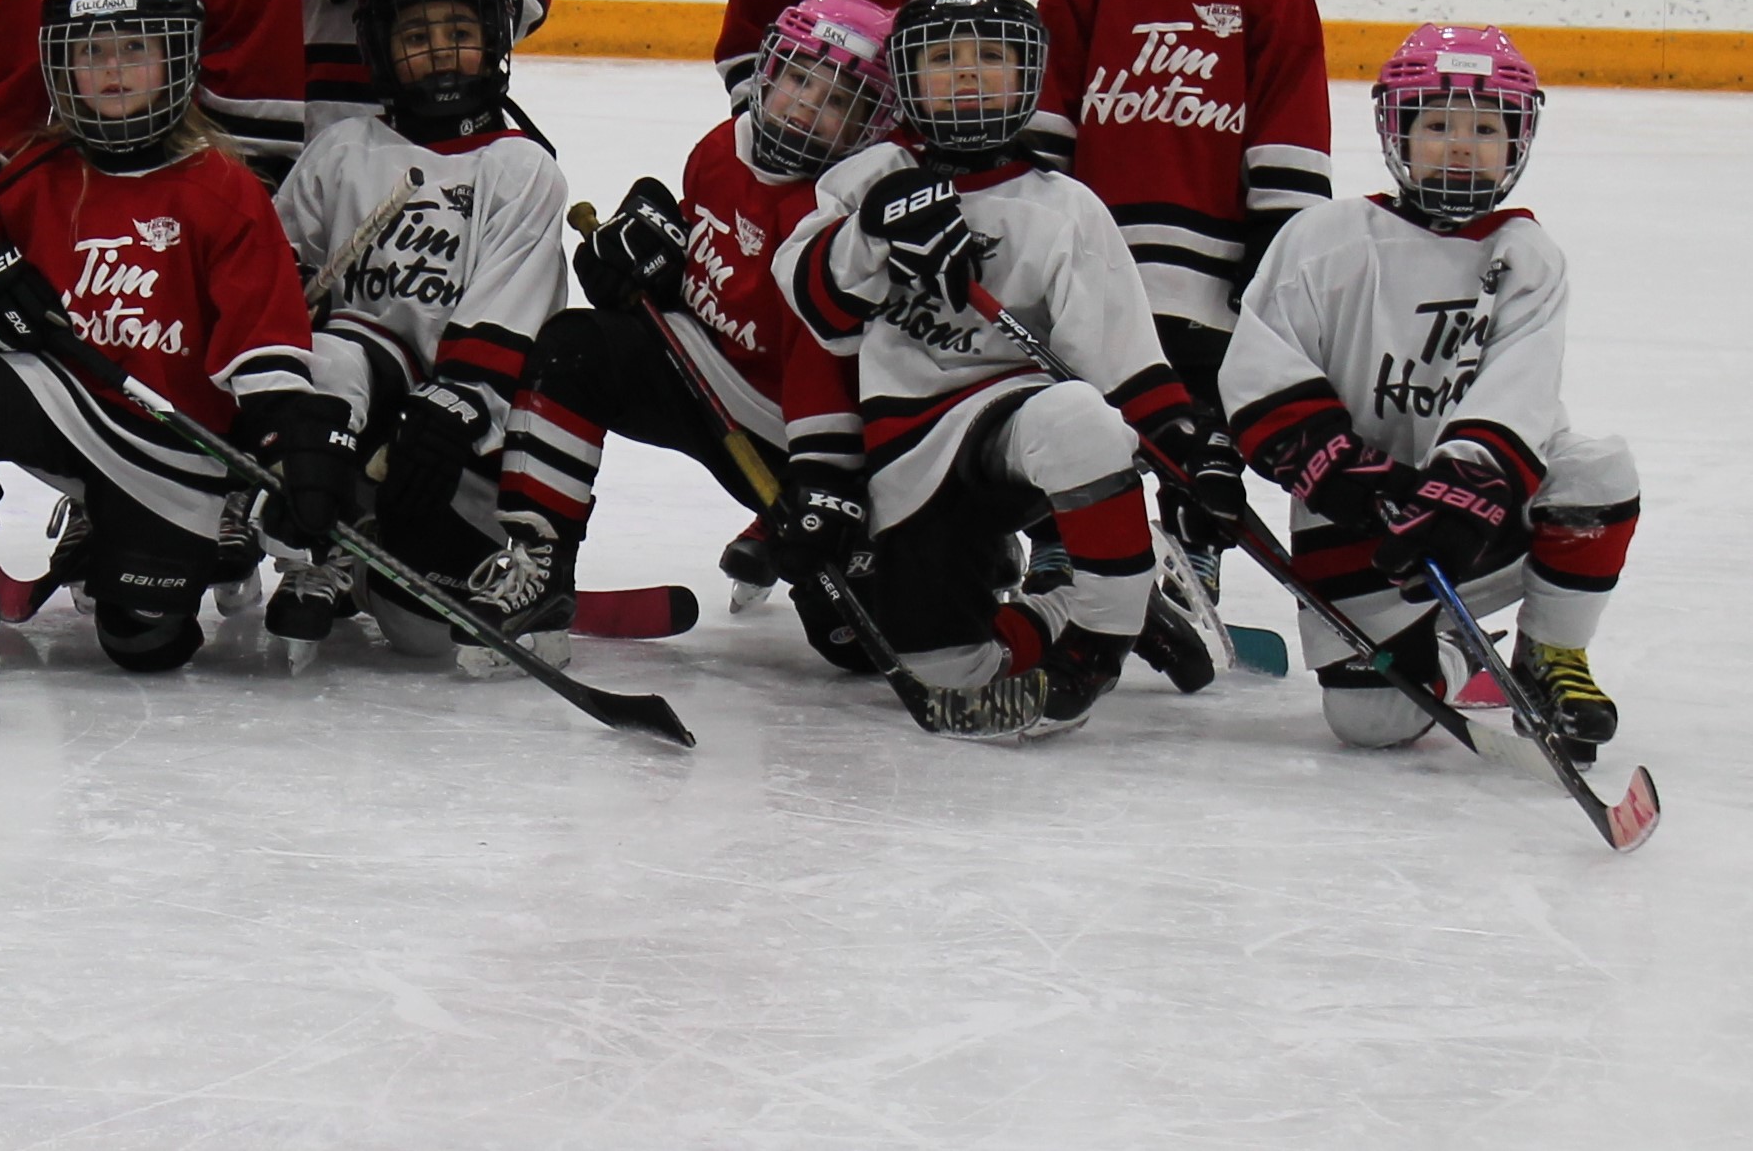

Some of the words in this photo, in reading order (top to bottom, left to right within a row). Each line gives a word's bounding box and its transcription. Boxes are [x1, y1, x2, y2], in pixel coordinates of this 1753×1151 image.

[1132, 22, 1219, 80] Tim
[1081, 66, 1246, 134] Hortons
[74, 236, 159, 299] Tim
[688, 203, 734, 290] Tim
[62, 289, 184, 356] ortons
[868, 284, 976, 355] rtons
